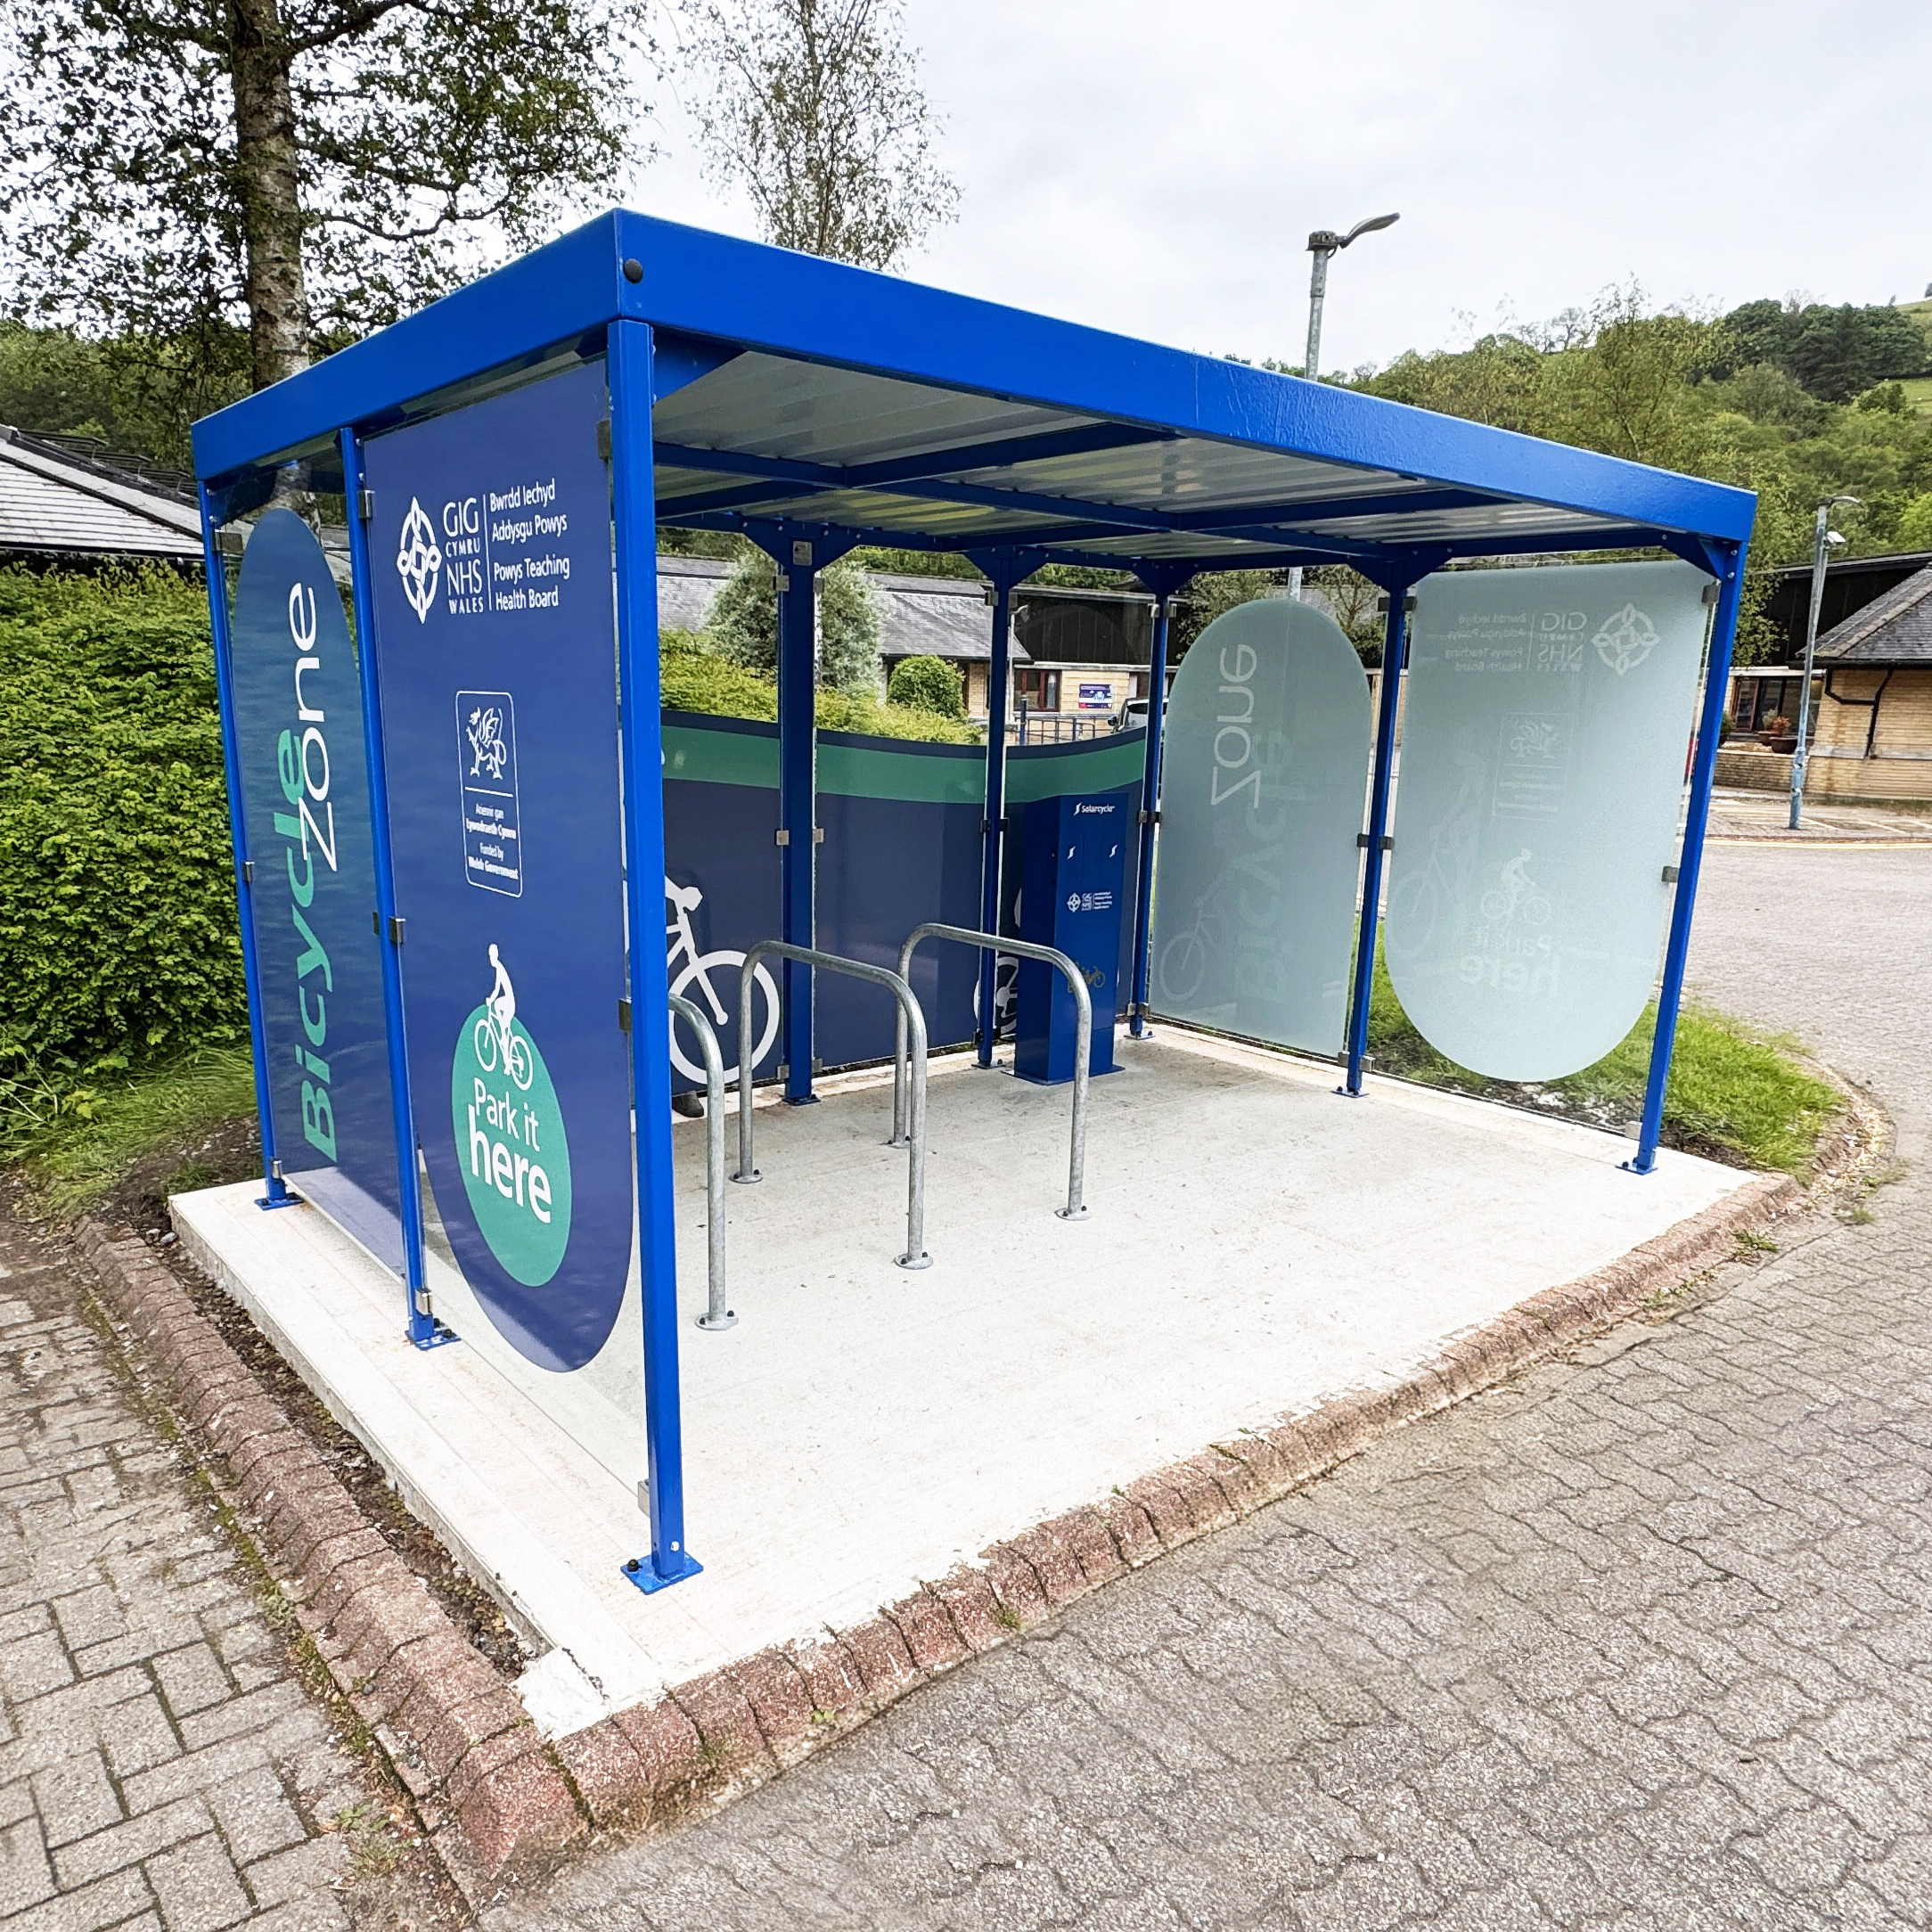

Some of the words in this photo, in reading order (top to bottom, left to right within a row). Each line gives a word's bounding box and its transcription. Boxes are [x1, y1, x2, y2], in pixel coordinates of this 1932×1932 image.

[489, 486, 520, 512] Bwrdd
[522, 478, 555, 508] Iechyd
[443, 497, 479, 537] GIG
[492, 519, 533, 544] Addysgu
[535, 513, 567, 537] Powys
[445, 537, 480, 558] CYMRU
[446, 559, 483, 596] NHS
[494, 561, 523, 585] Powys
[524, 553, 570, 579] Teaching
[448, 596, 484, 615] WALES
[495, 587, 527, 610] Health
[528, 585, 559, 609] Board
[273, 728, 339, 1164] Bicycle
[473, 1077, 520, 1140] Park
[524, 1101, 540, 1151] it
[468, 1103, 552, 1224] here
